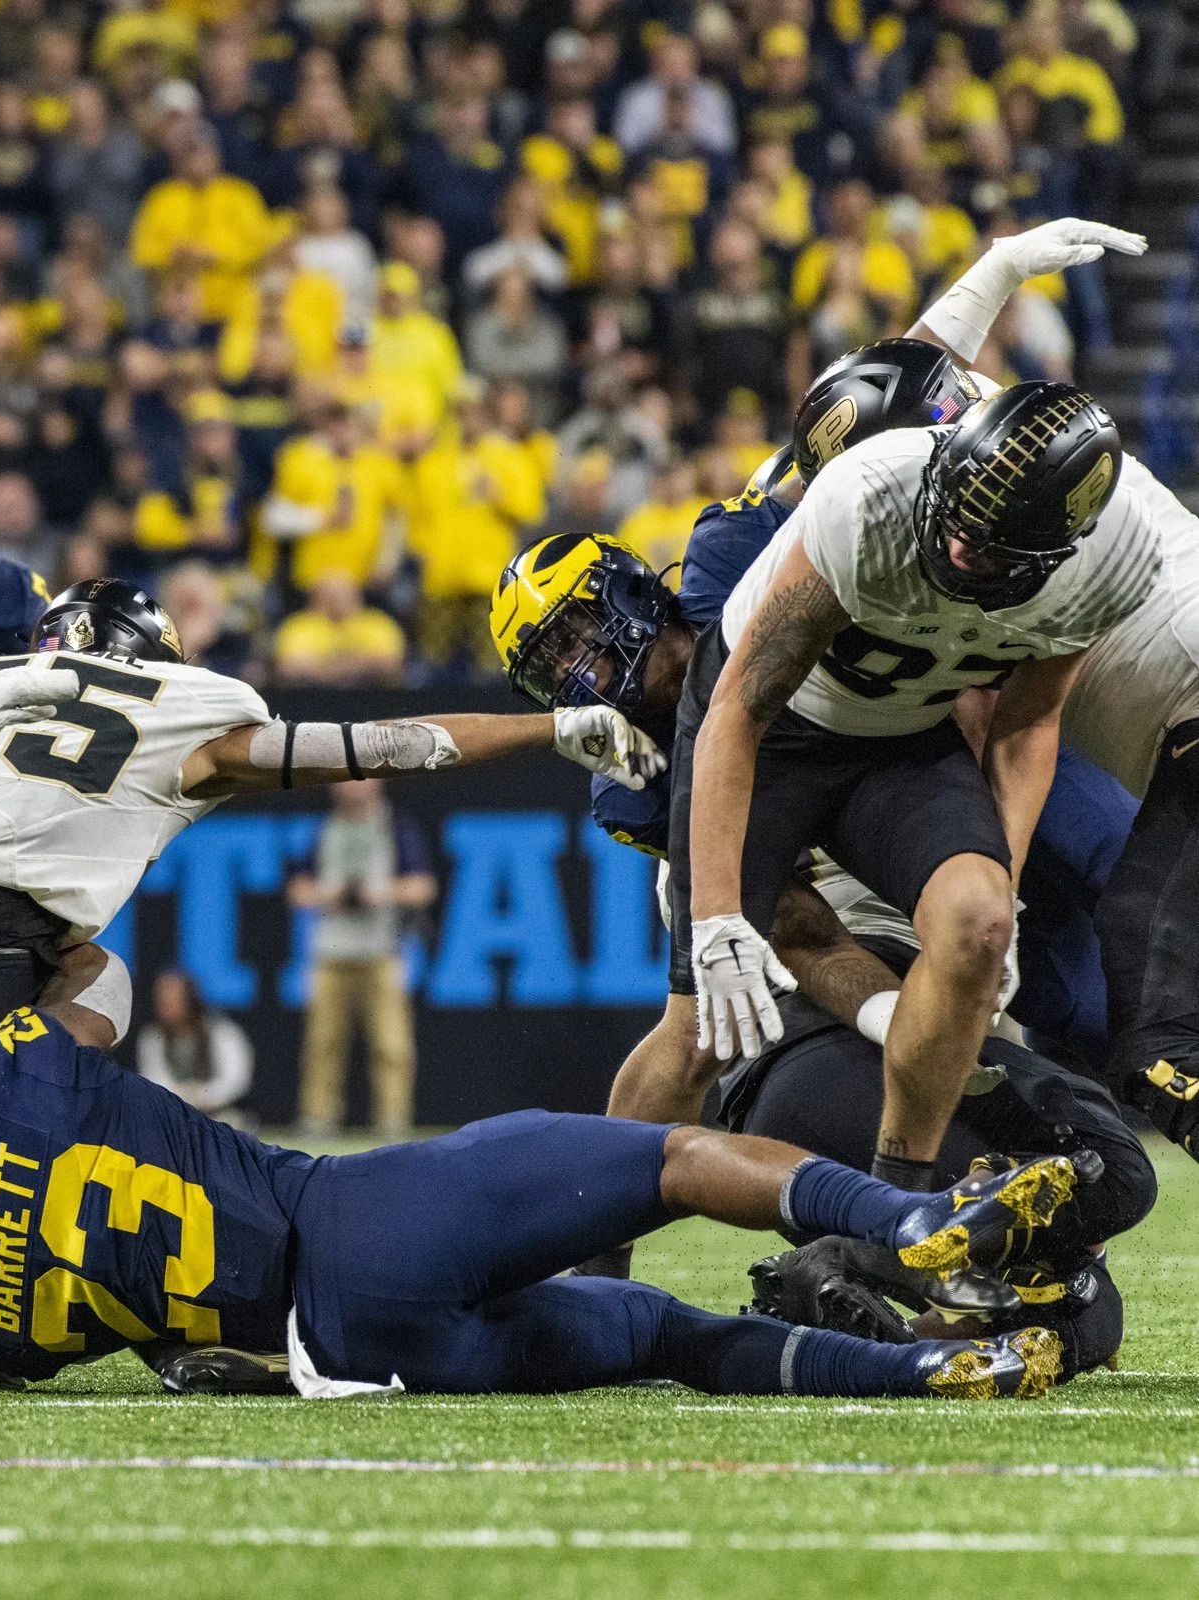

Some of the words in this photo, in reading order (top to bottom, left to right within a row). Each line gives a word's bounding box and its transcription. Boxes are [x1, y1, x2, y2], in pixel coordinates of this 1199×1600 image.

[807, 394, 858, 472] P
[1065, 452, 1113, 532] P
[31, 1144, 221, 1352] 23
